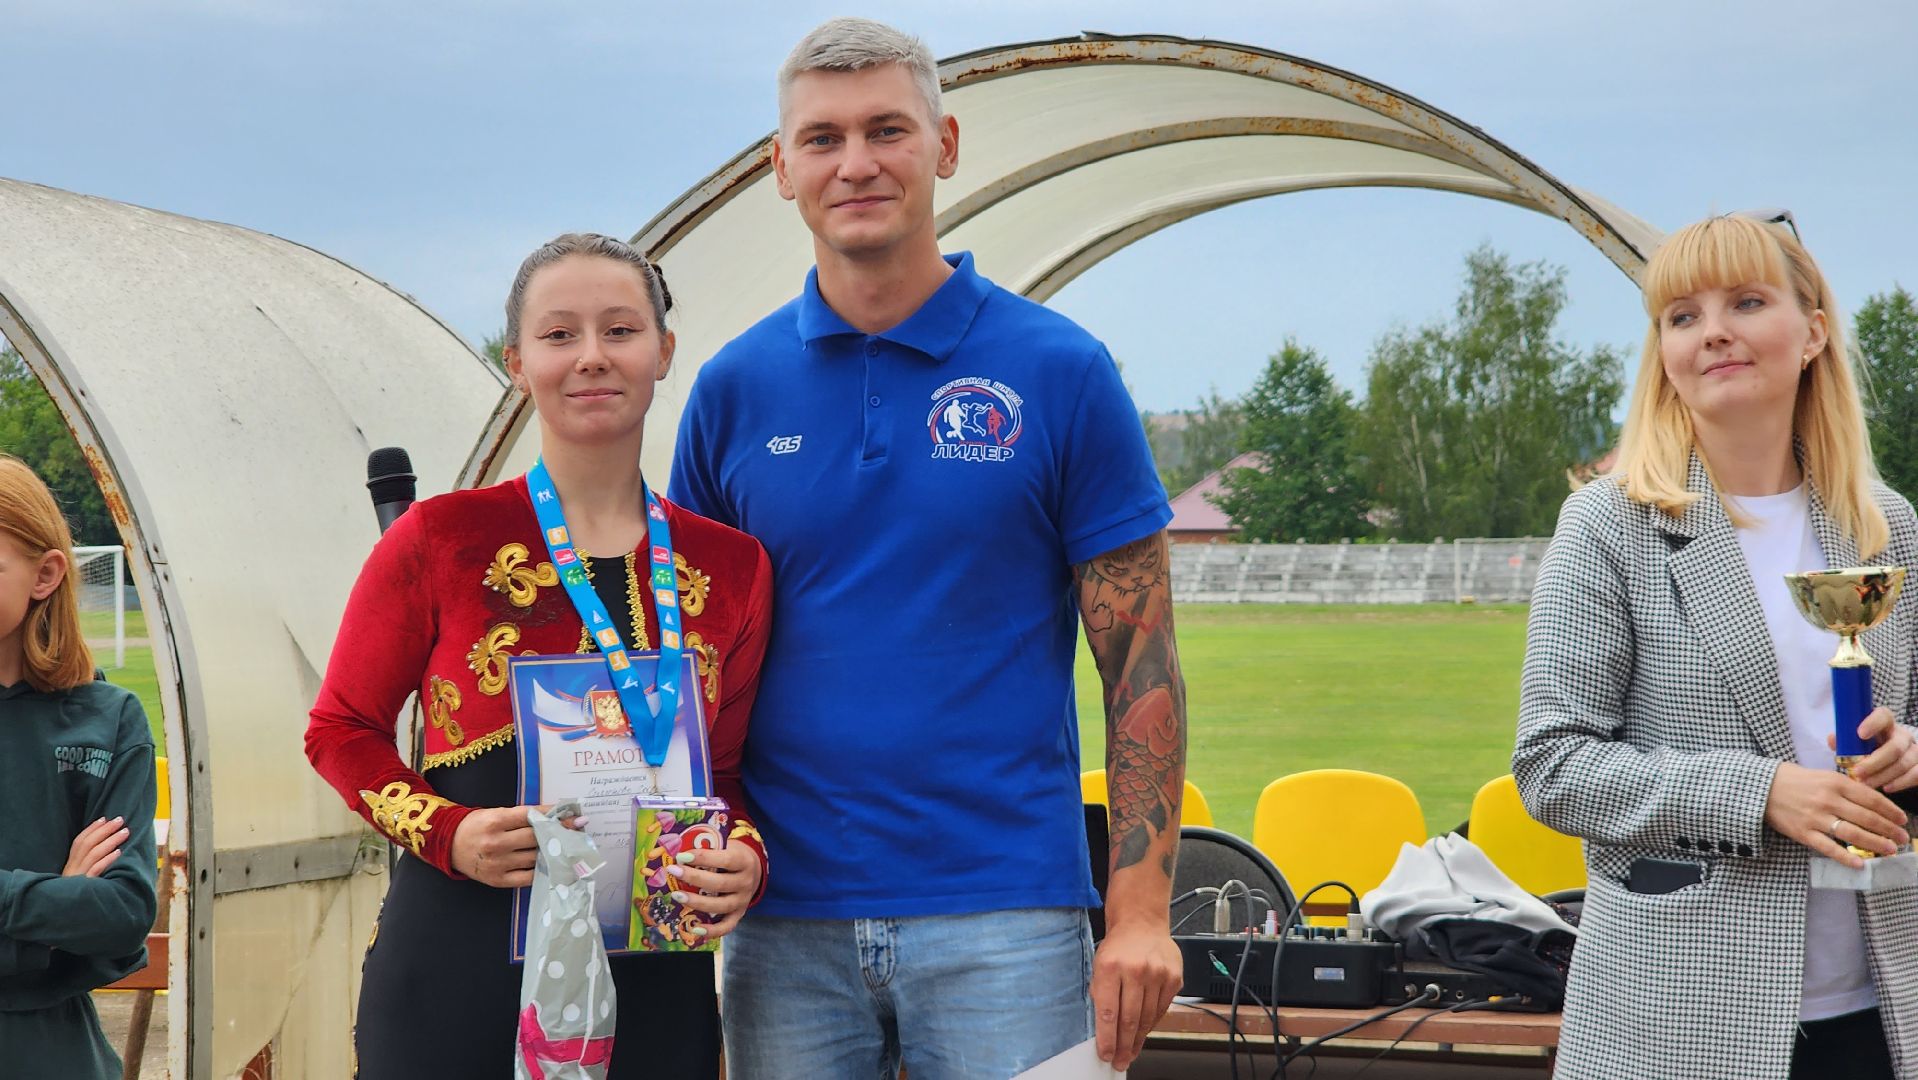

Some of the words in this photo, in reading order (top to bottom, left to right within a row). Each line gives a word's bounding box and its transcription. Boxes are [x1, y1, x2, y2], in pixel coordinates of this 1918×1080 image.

[931, 377, 991, 400] СПОРТИВНАЯ
[931, 443, 1015, 462] ЛИДЕР
[55, 746, 83, 764] GOOD
[574, 748, 643, 767] ГРАМОТ
